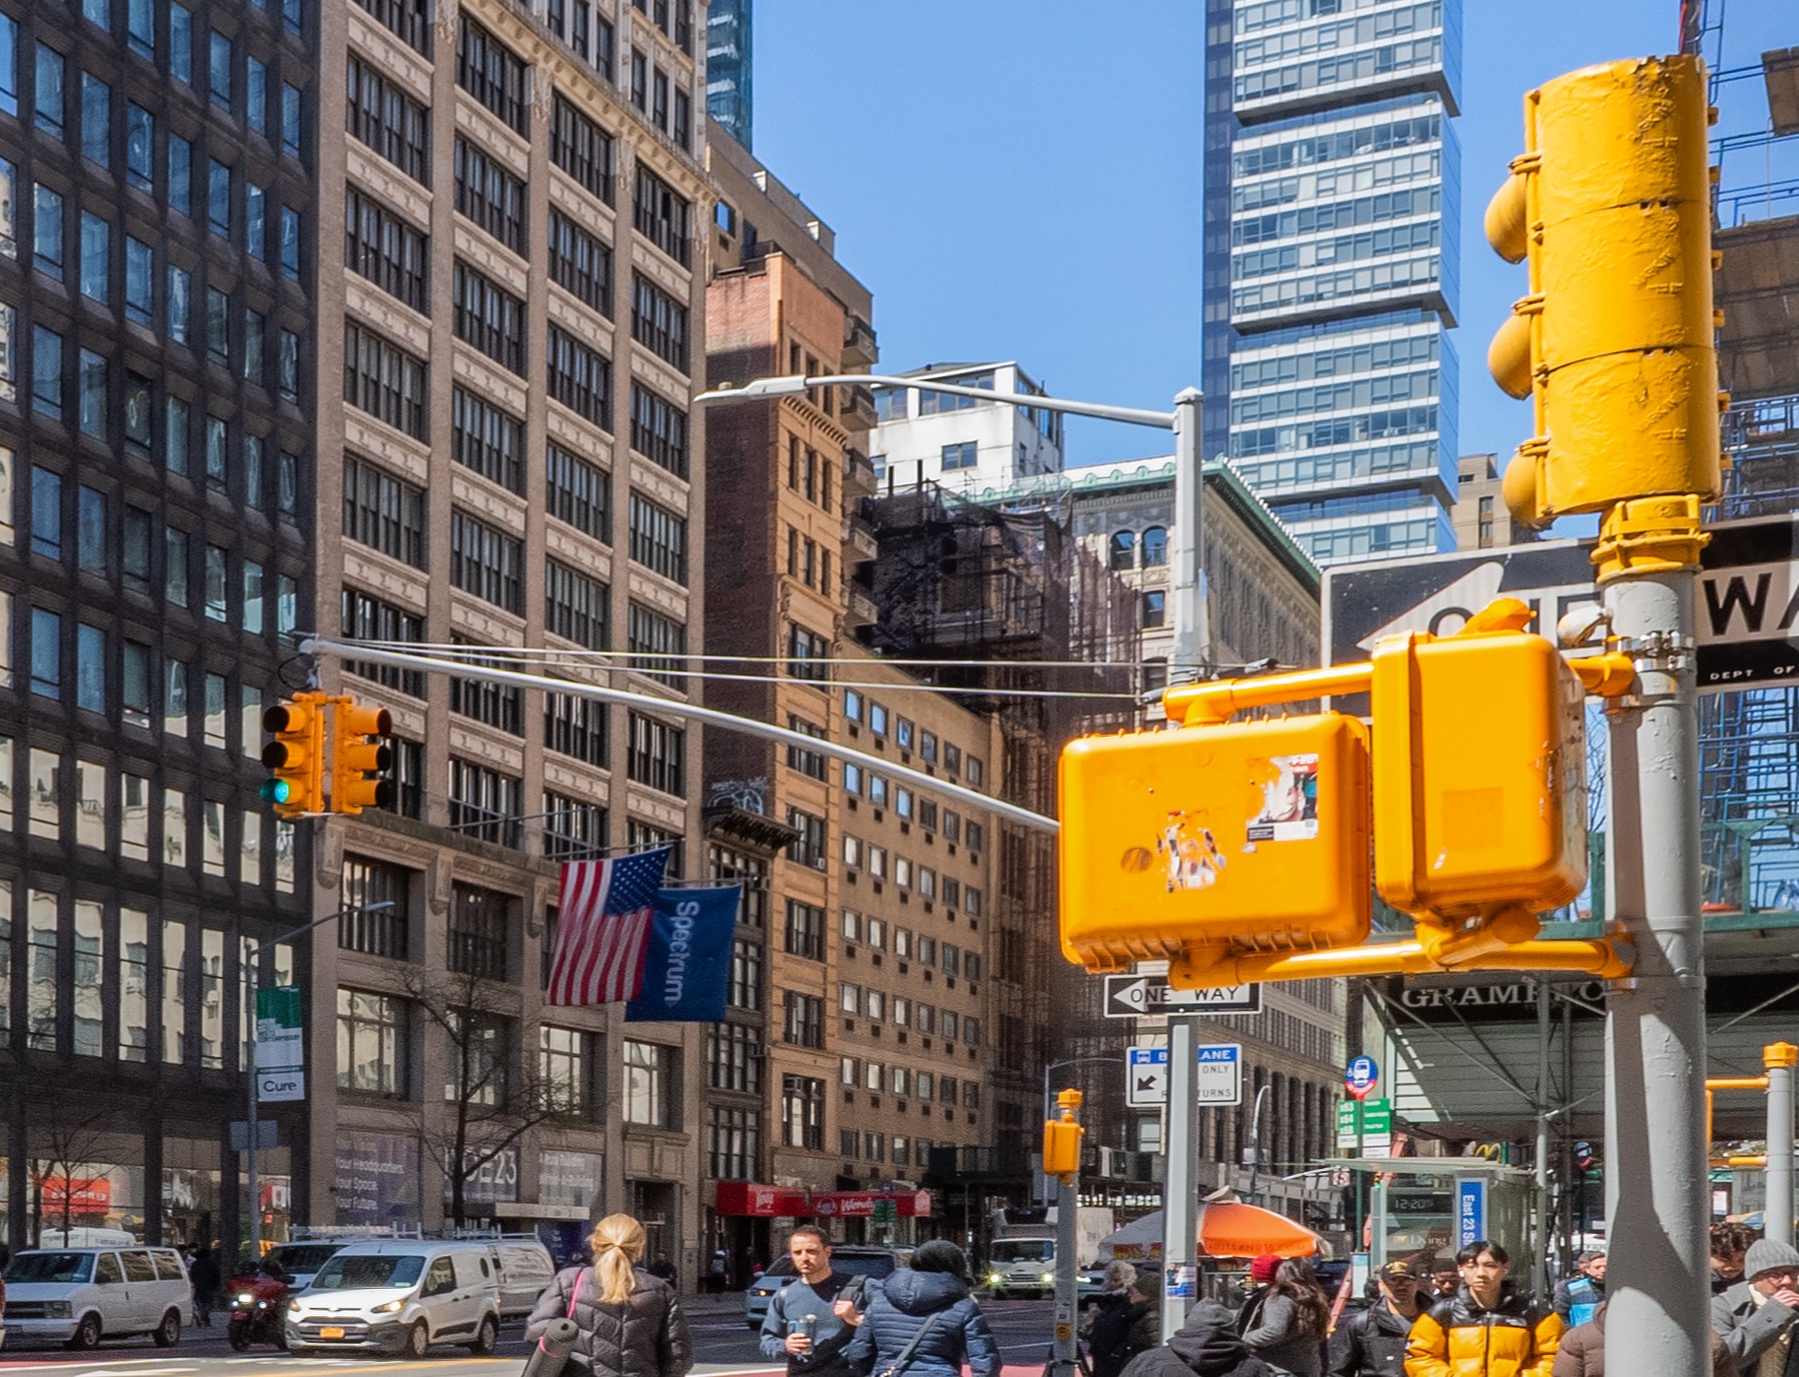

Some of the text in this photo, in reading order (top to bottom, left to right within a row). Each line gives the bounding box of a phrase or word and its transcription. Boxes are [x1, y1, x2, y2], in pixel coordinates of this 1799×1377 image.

[1709, 664, 1795, 681] DEPT OF
[664, 901, 700, 1001] Spectrum
[1130, 986, 1239, 1003] ONE WAY
[1201, 1050, 1231, 1060] ANE
[1203, 1064, 1231, 1074] ONLY
[263, 1080, 297, 1093] Cure
[1462, 1194, 1475, 1216] East
[1462, 1218, 1475, 1231] 23
